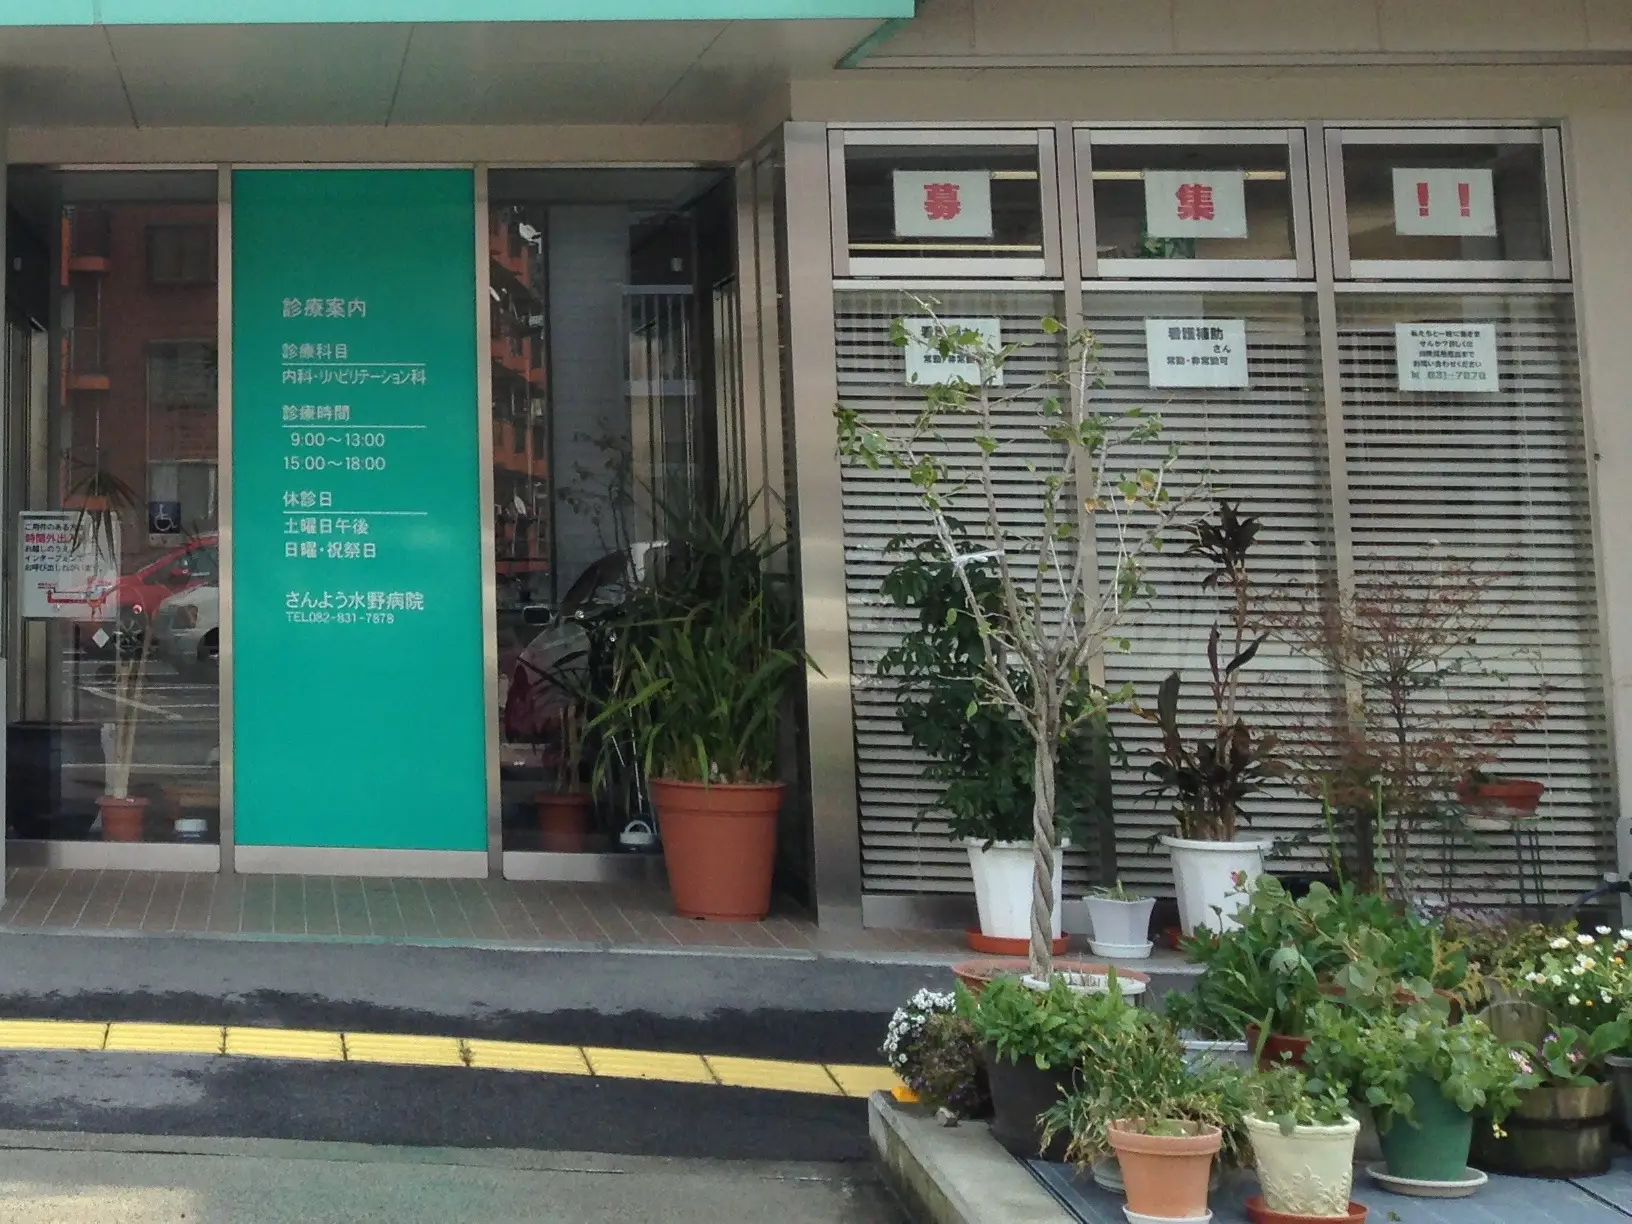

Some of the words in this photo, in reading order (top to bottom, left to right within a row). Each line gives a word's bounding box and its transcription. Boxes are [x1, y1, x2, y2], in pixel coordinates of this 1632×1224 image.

[923, 182, 961, 220] 募
[1175, 182, 1215, 220] 集
[282, 297, 367, 318] 診療案内
[281, 342, 349, 359] 診療科目
[1212, 344, 1232, 354] さん
[281, 368, 427, 385] 内科・リハビリテーション科
[282, 405, 350, 421] 診療時間
[282, 490, 333, 507] 休診日
[283, 517, 370, 535] 土曜日午後
[285, 541, 377, 559] 日曜・祝祭日
[285, 591, 425, 610] さんよう水野病院
